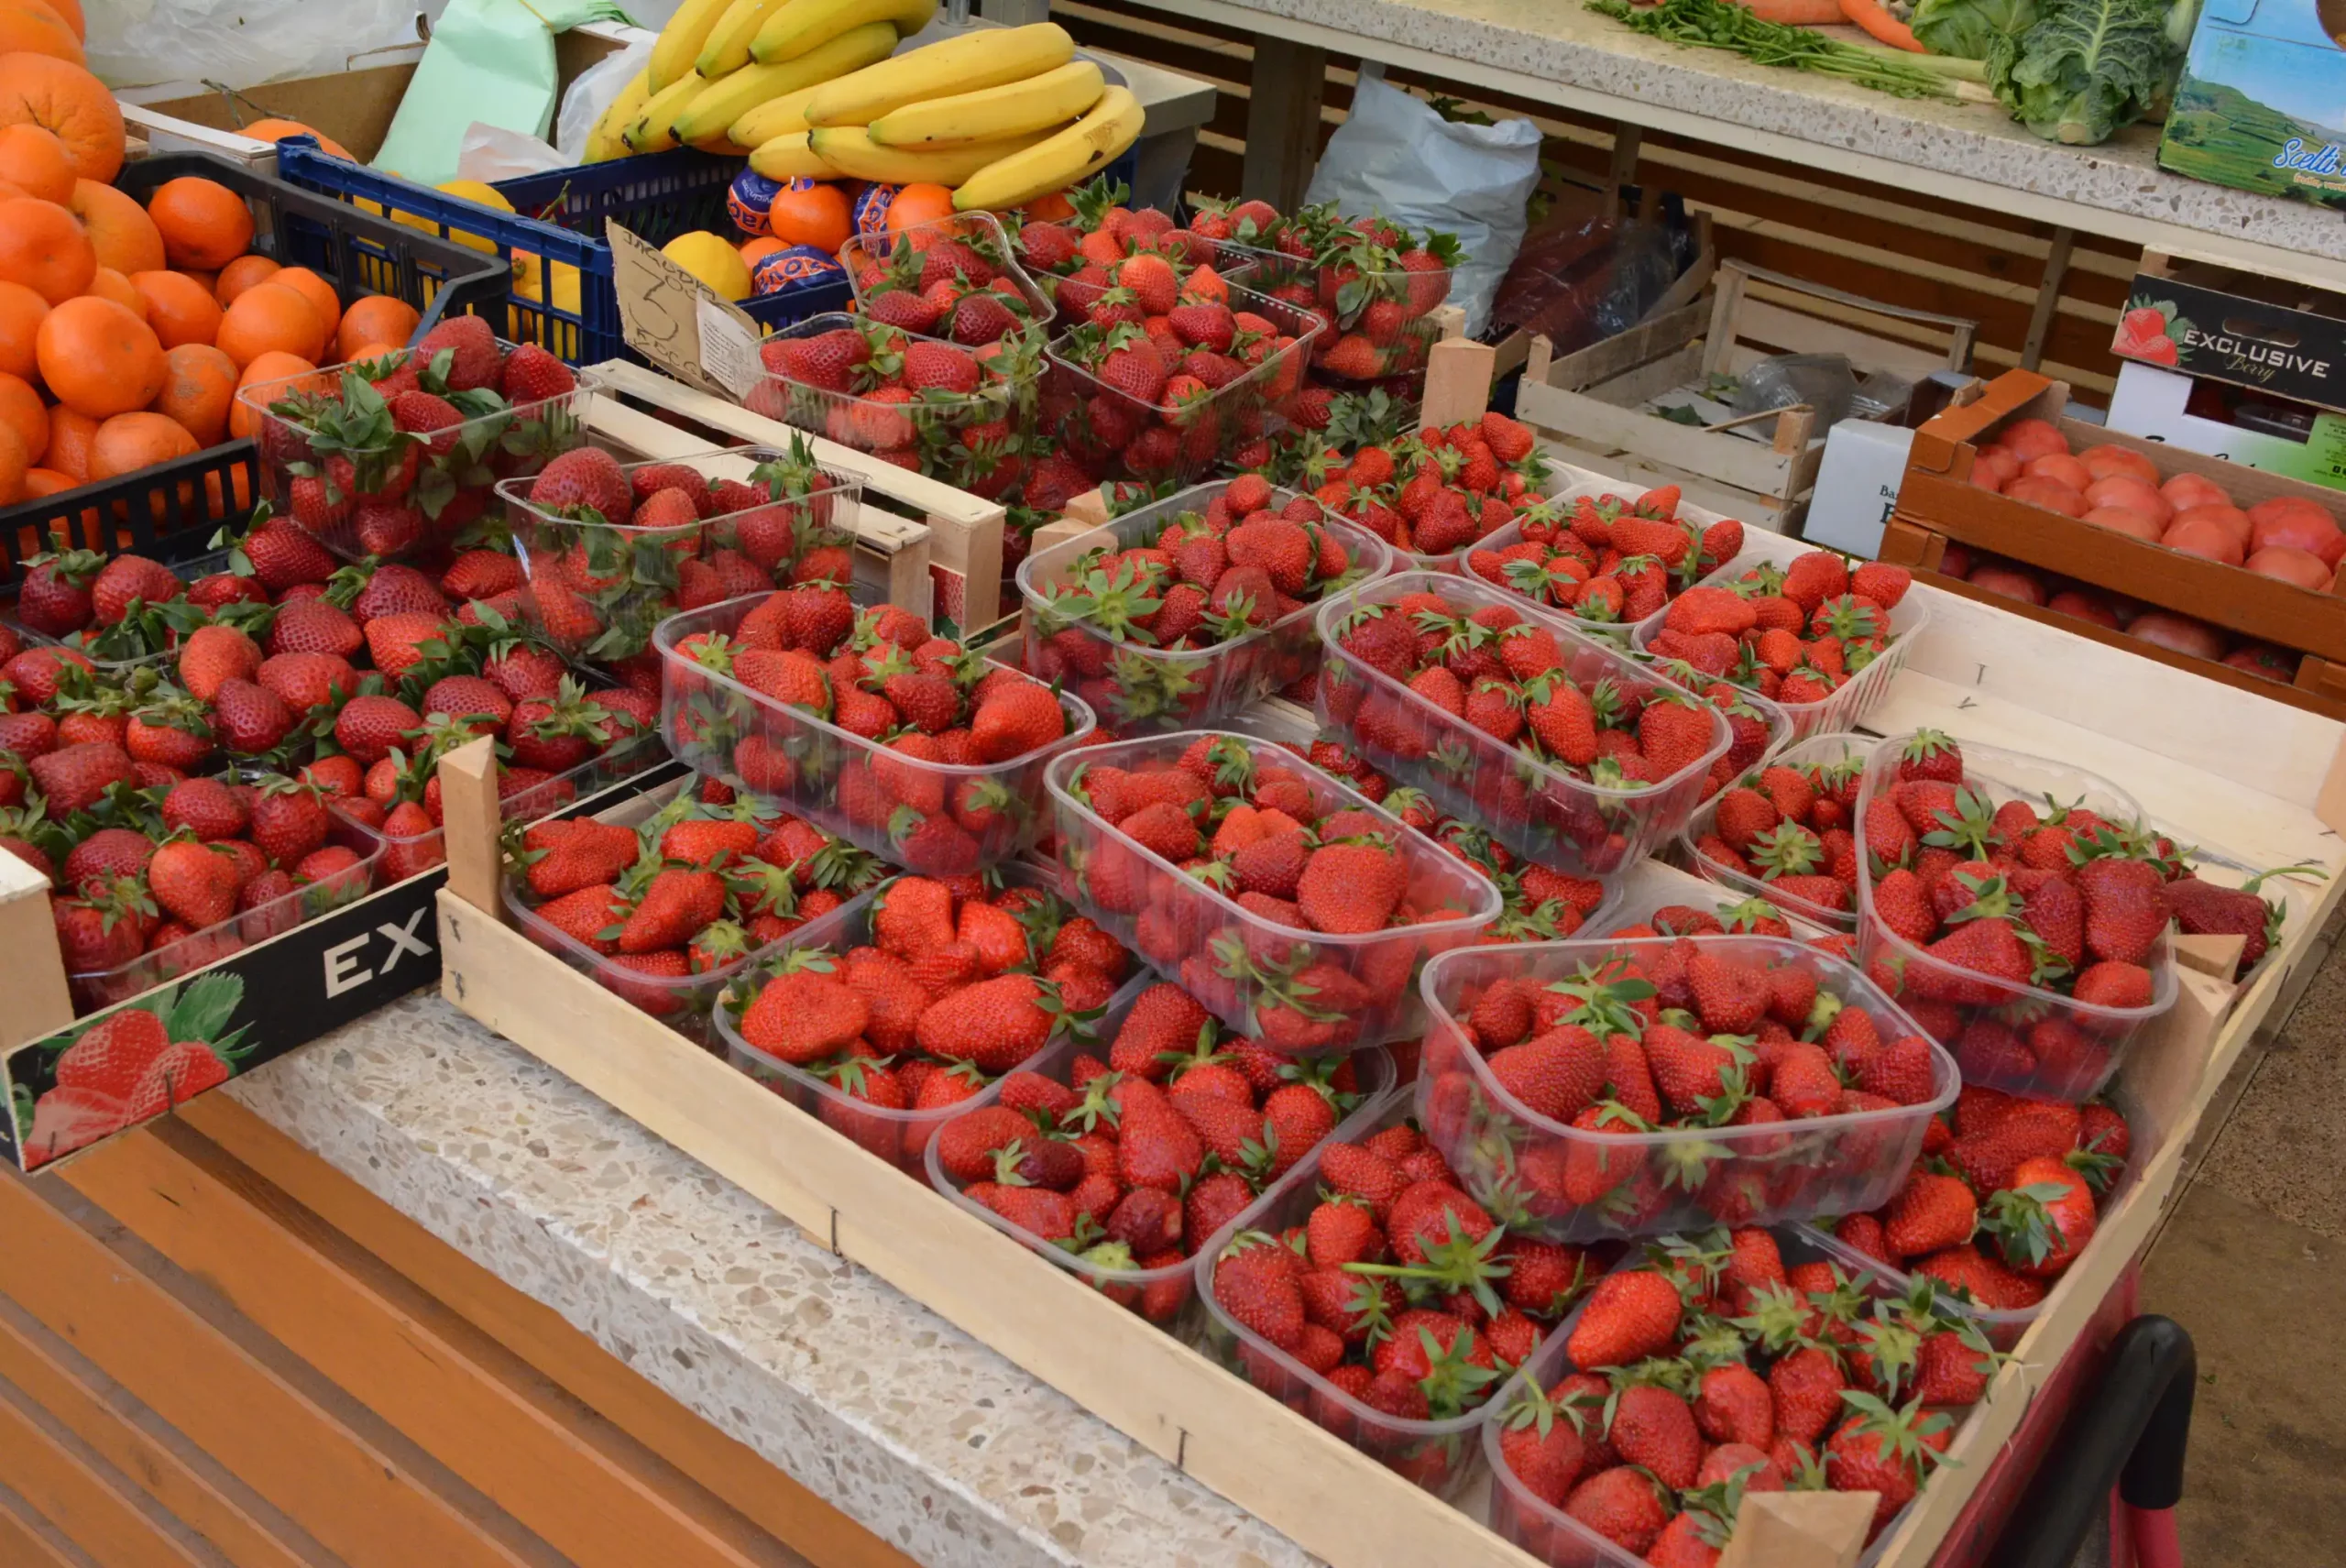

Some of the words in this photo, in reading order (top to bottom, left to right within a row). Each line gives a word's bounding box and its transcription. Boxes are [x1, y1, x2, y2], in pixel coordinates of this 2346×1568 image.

[2273, 137, 2340, 175] Scelti
[2183, 328, 2331, 378] EXCLUSIVE
[2227, 356, 2275, 382] Berry
